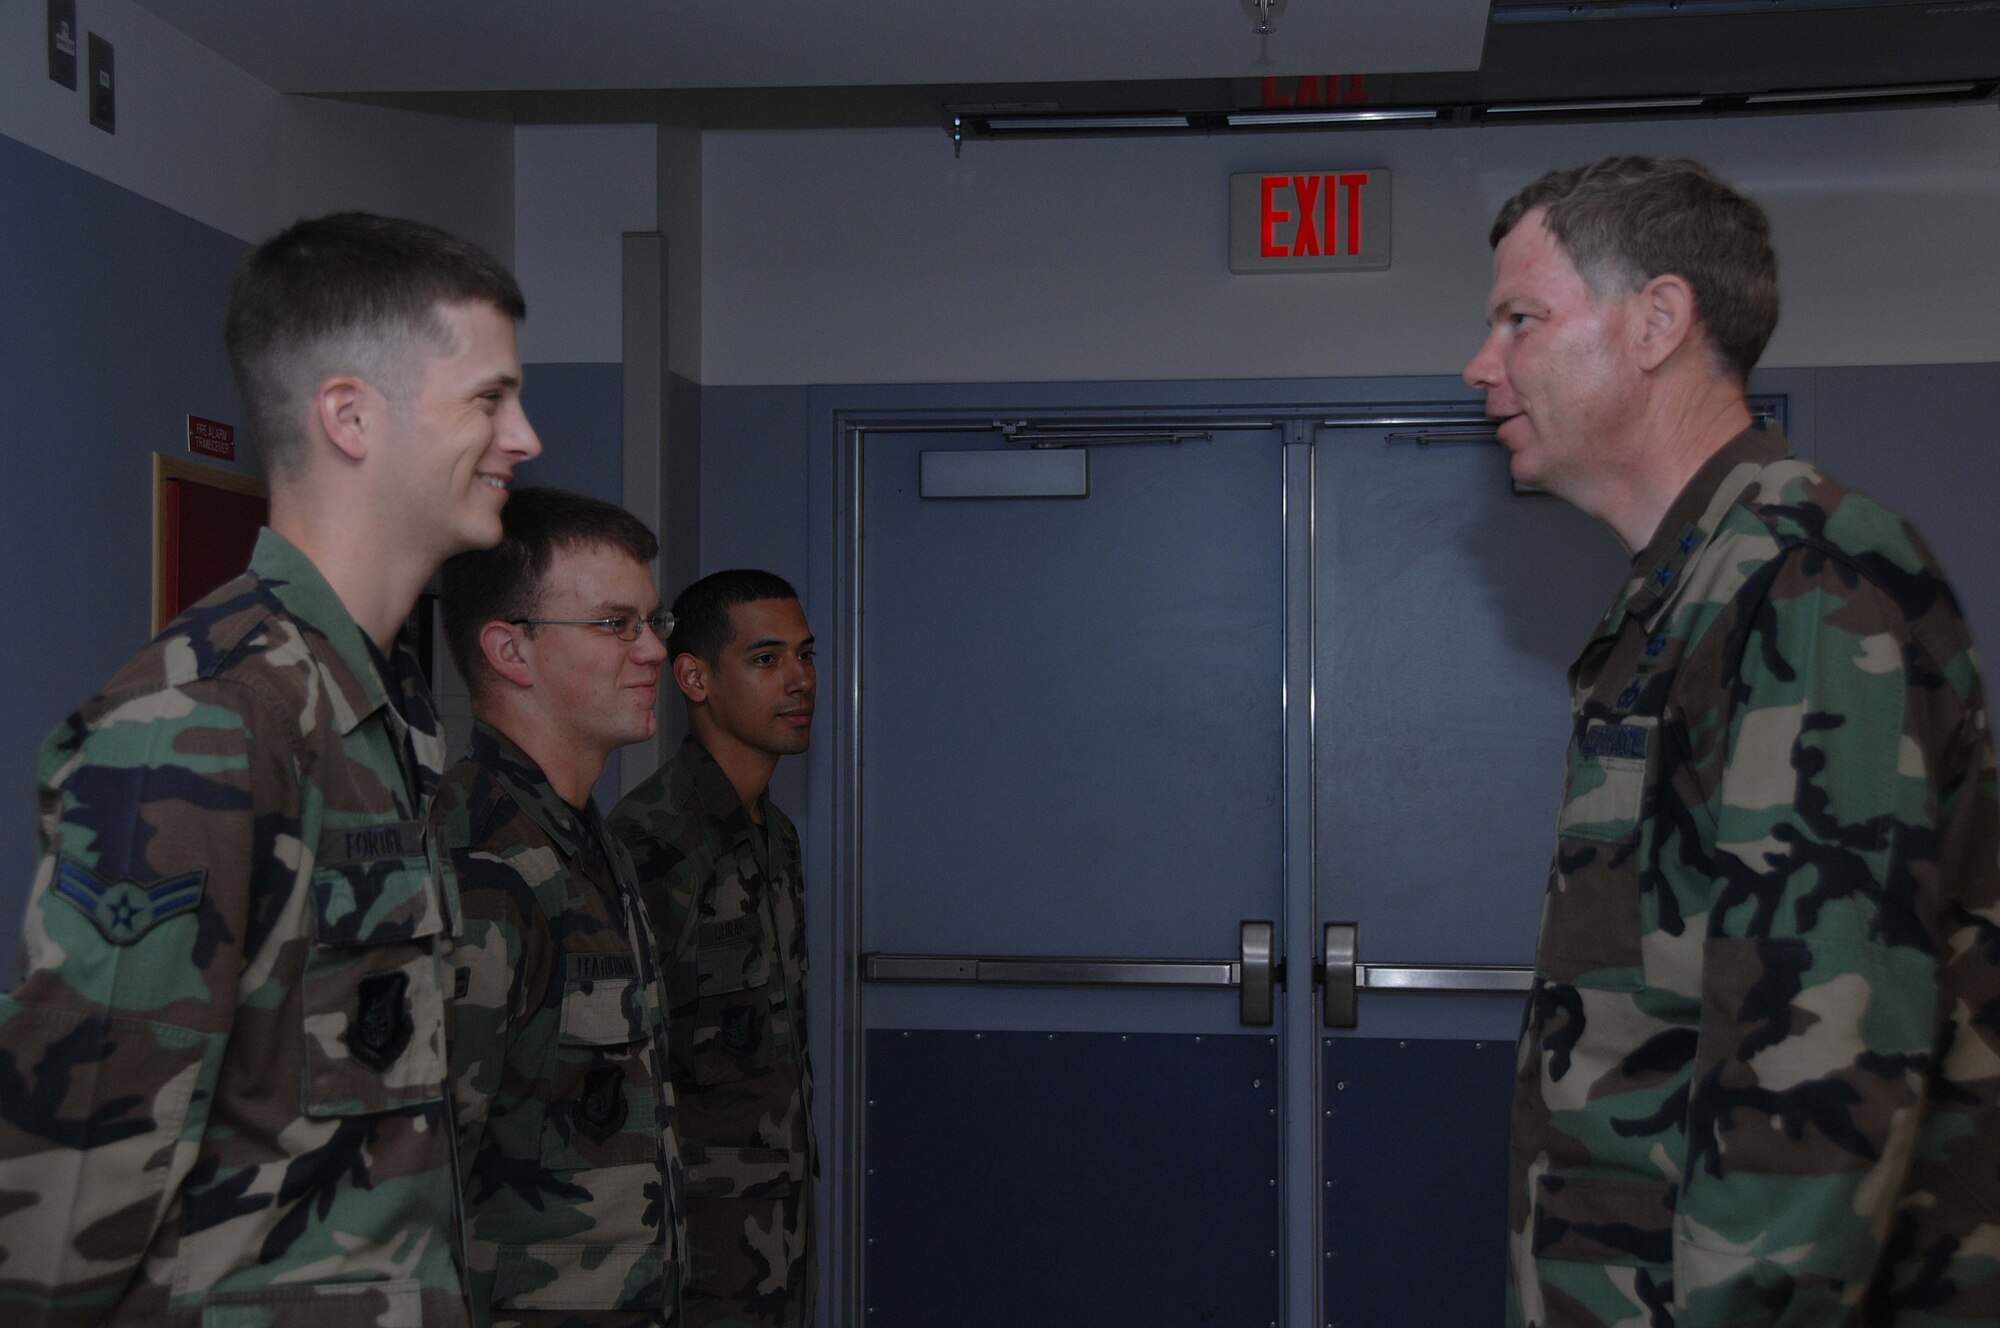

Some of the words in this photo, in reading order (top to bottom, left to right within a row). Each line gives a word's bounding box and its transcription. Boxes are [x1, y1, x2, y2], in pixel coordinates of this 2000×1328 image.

[1261, 174, 1368, 257] EXIT
[196, 423, 208, 437] FIRE
[208, 426, 227, 442] ALARM
